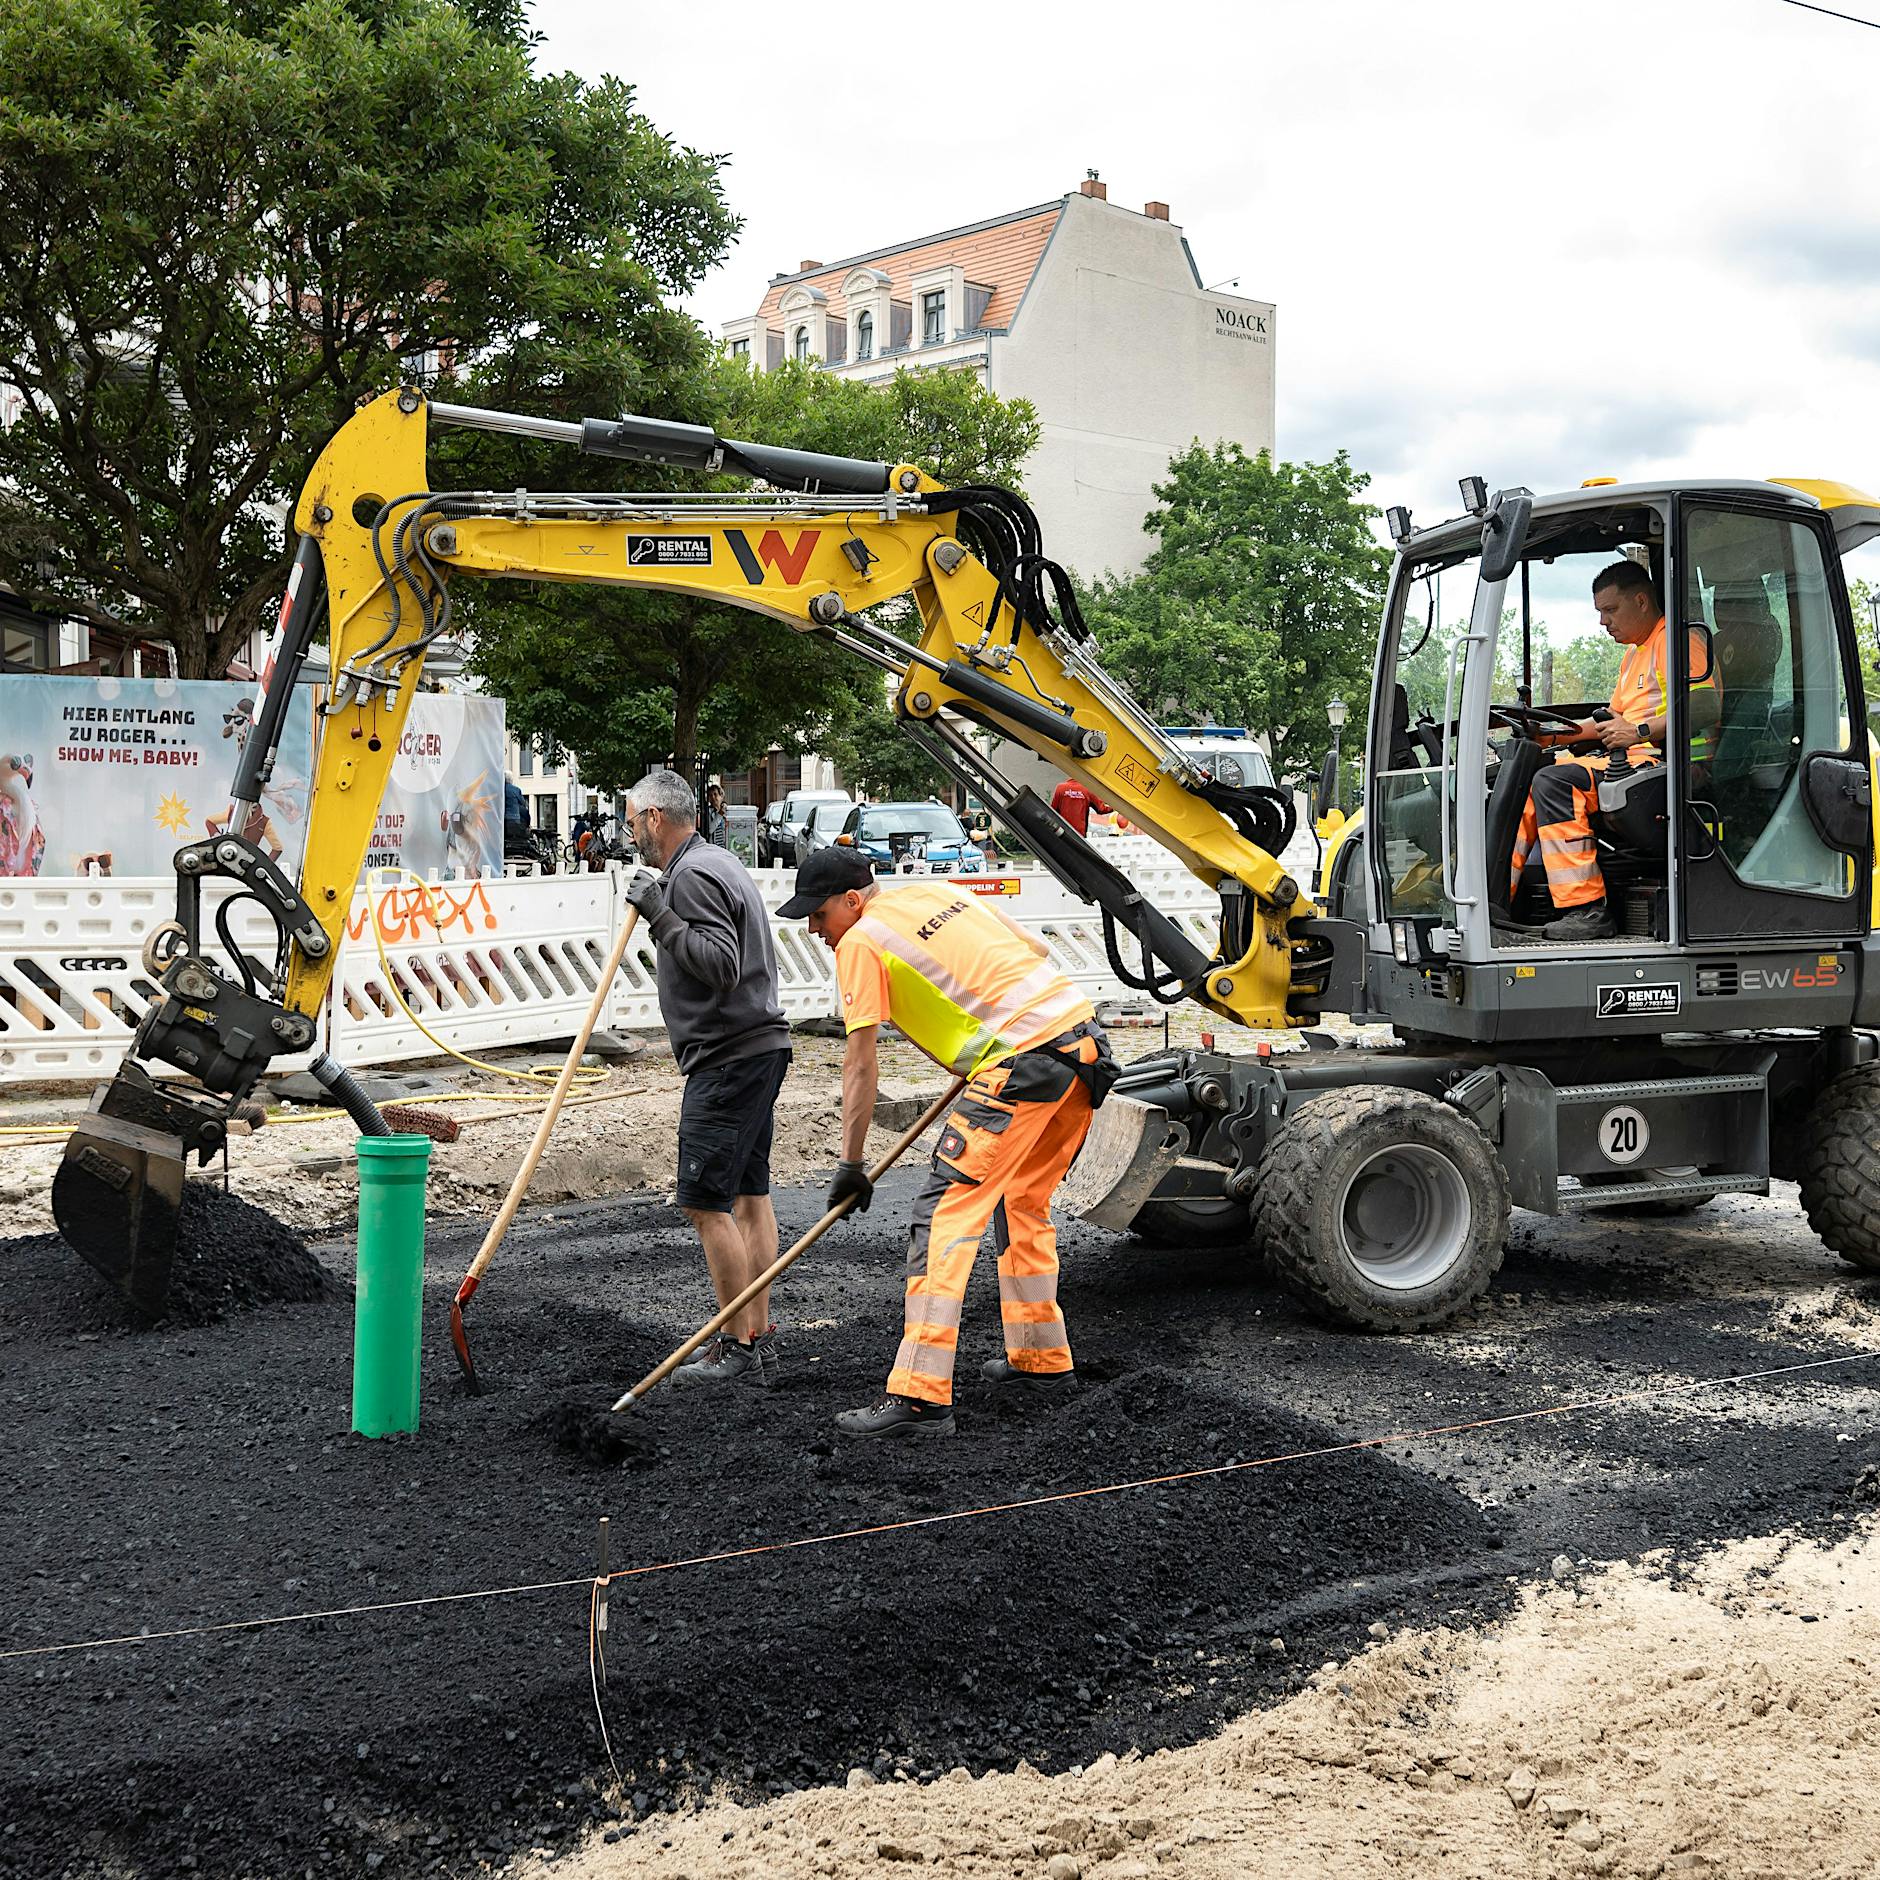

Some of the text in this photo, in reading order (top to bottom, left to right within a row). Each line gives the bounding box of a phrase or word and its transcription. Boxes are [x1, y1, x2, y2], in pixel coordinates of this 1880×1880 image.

[1216, 308, 1266, 333] NOACK
[657, 541, 708, 551] RENTAL
[63, 707, 195, 725] HIER ENTLANG
[69, 727, 92, 741] ZU
[97, 728, 156, 744] ROGER
[58, 747, 198, 766] SHOW ME, BABY!
[385, 815, 405, 828] DU?
[369, 834, 402, 848] OGER!
[917, 901, 969, 941] KEMNA
[1741, 967, 1838, 990] EW65
[1627, 989, 1676, 1002] RENTAL
[1611, 1116, 1637, 1152] 20
